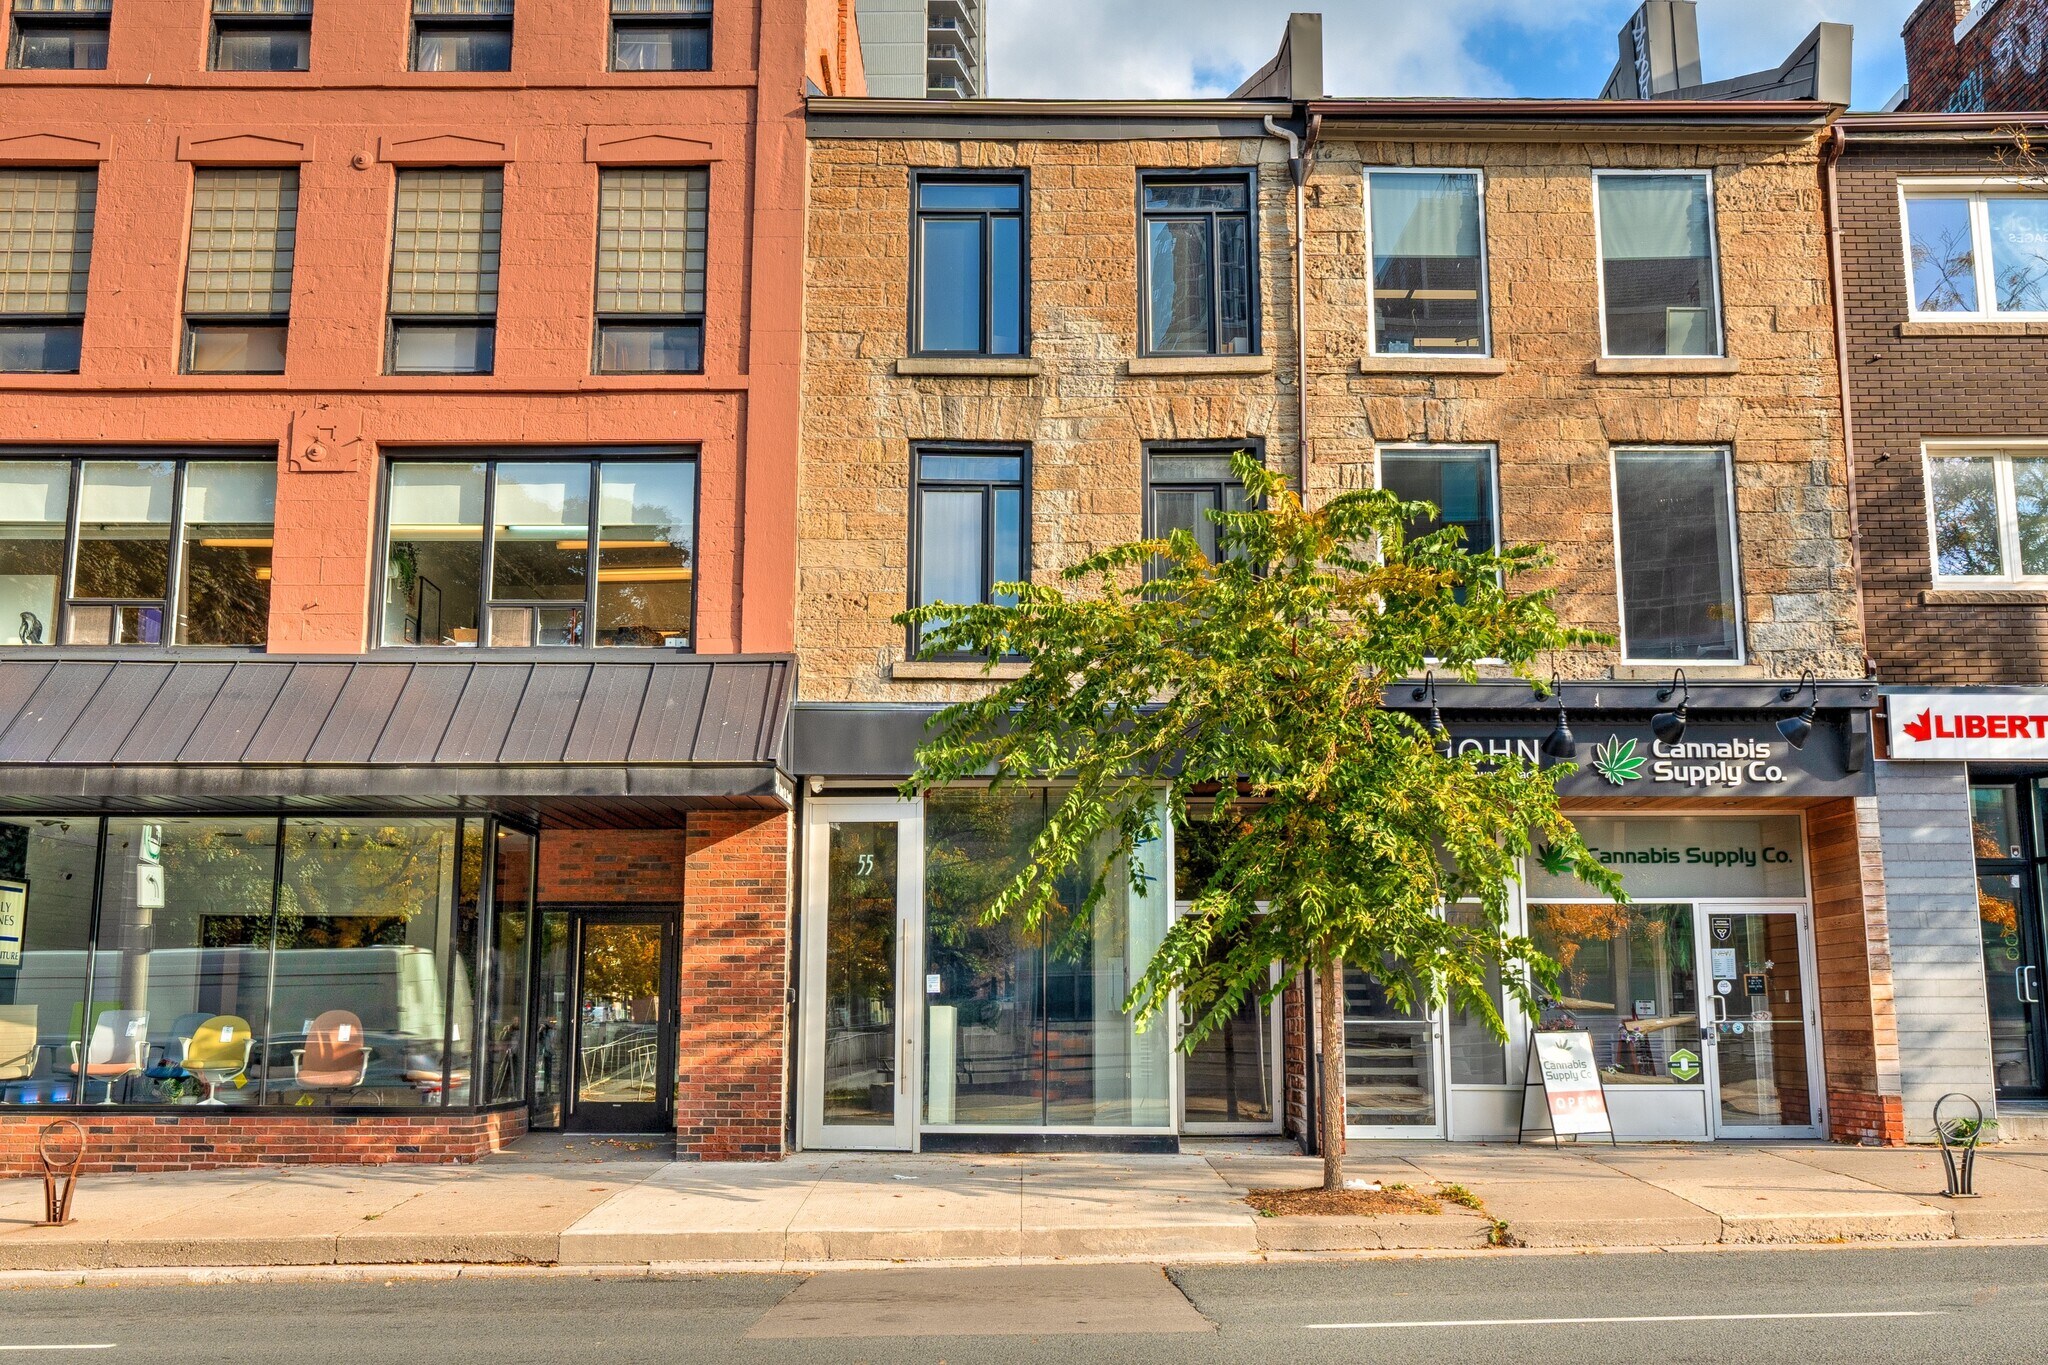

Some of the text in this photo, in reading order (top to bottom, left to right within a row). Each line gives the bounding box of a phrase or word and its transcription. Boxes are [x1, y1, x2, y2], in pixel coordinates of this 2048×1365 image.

[1934, 715, 2048, 738] LIBERT
[1652, 738, 1771, 759] Cannabis
[1653, 761, 1788, 786] Supply Co.
[857, 854, 874, 876] 55
[1686, 847, 1757, 867] Supply
[1762, 847, 1793, 863] Co.
[1543, 1059, 1588, 1070] Cannabis
[1545, 1069, 1579, 1082] Supply
